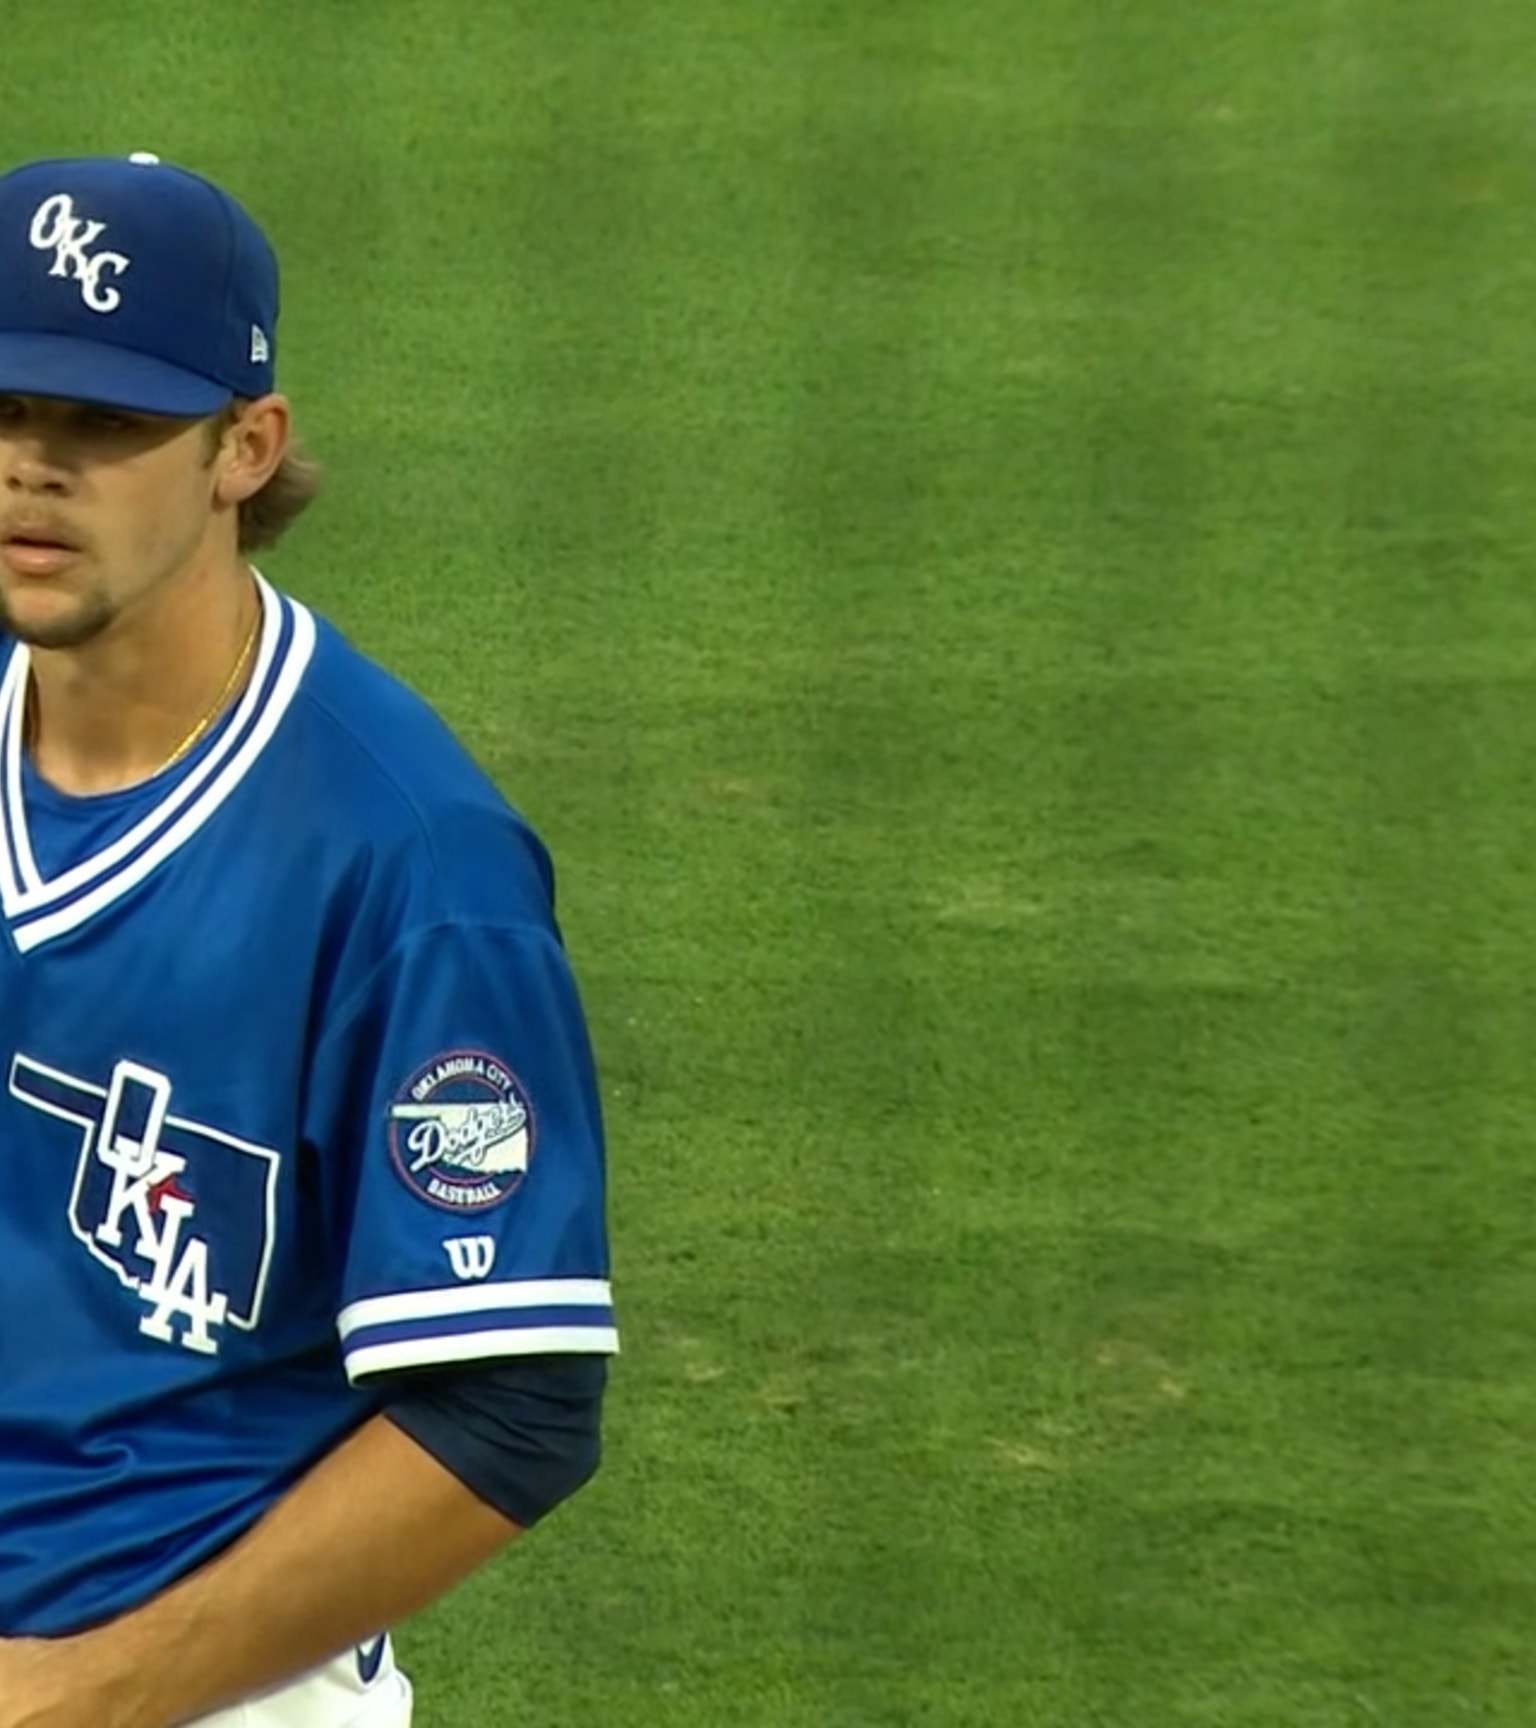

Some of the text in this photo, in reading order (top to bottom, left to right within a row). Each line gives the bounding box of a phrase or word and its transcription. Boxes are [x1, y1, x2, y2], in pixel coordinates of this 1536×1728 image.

[29, 193, 130, 313] OKC
[411, 1057, 513, 1101] OKLAHOMA CITY
[408, 1093, 526, 1172] Dodgers
[427, 1180, 501, 1205] BASEBALL
